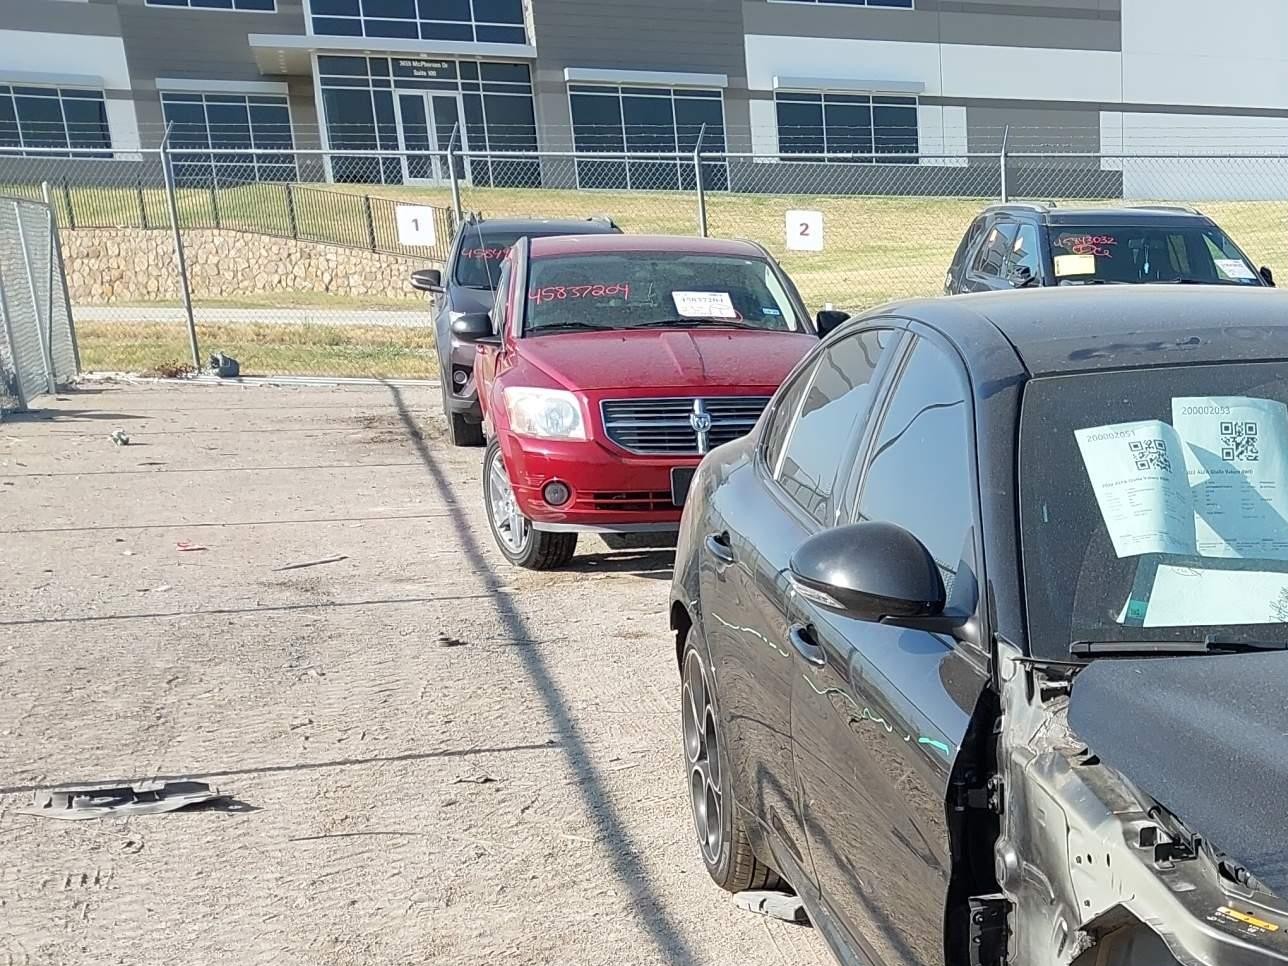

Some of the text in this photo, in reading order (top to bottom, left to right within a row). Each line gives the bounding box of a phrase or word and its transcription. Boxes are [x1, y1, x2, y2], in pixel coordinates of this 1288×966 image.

[410, 218, 420, 232] 1
[799, 222, 810, 237] 2
[527, 282, 629, 305] 45837204
[1181, 405, 1231, 416] 200002053
